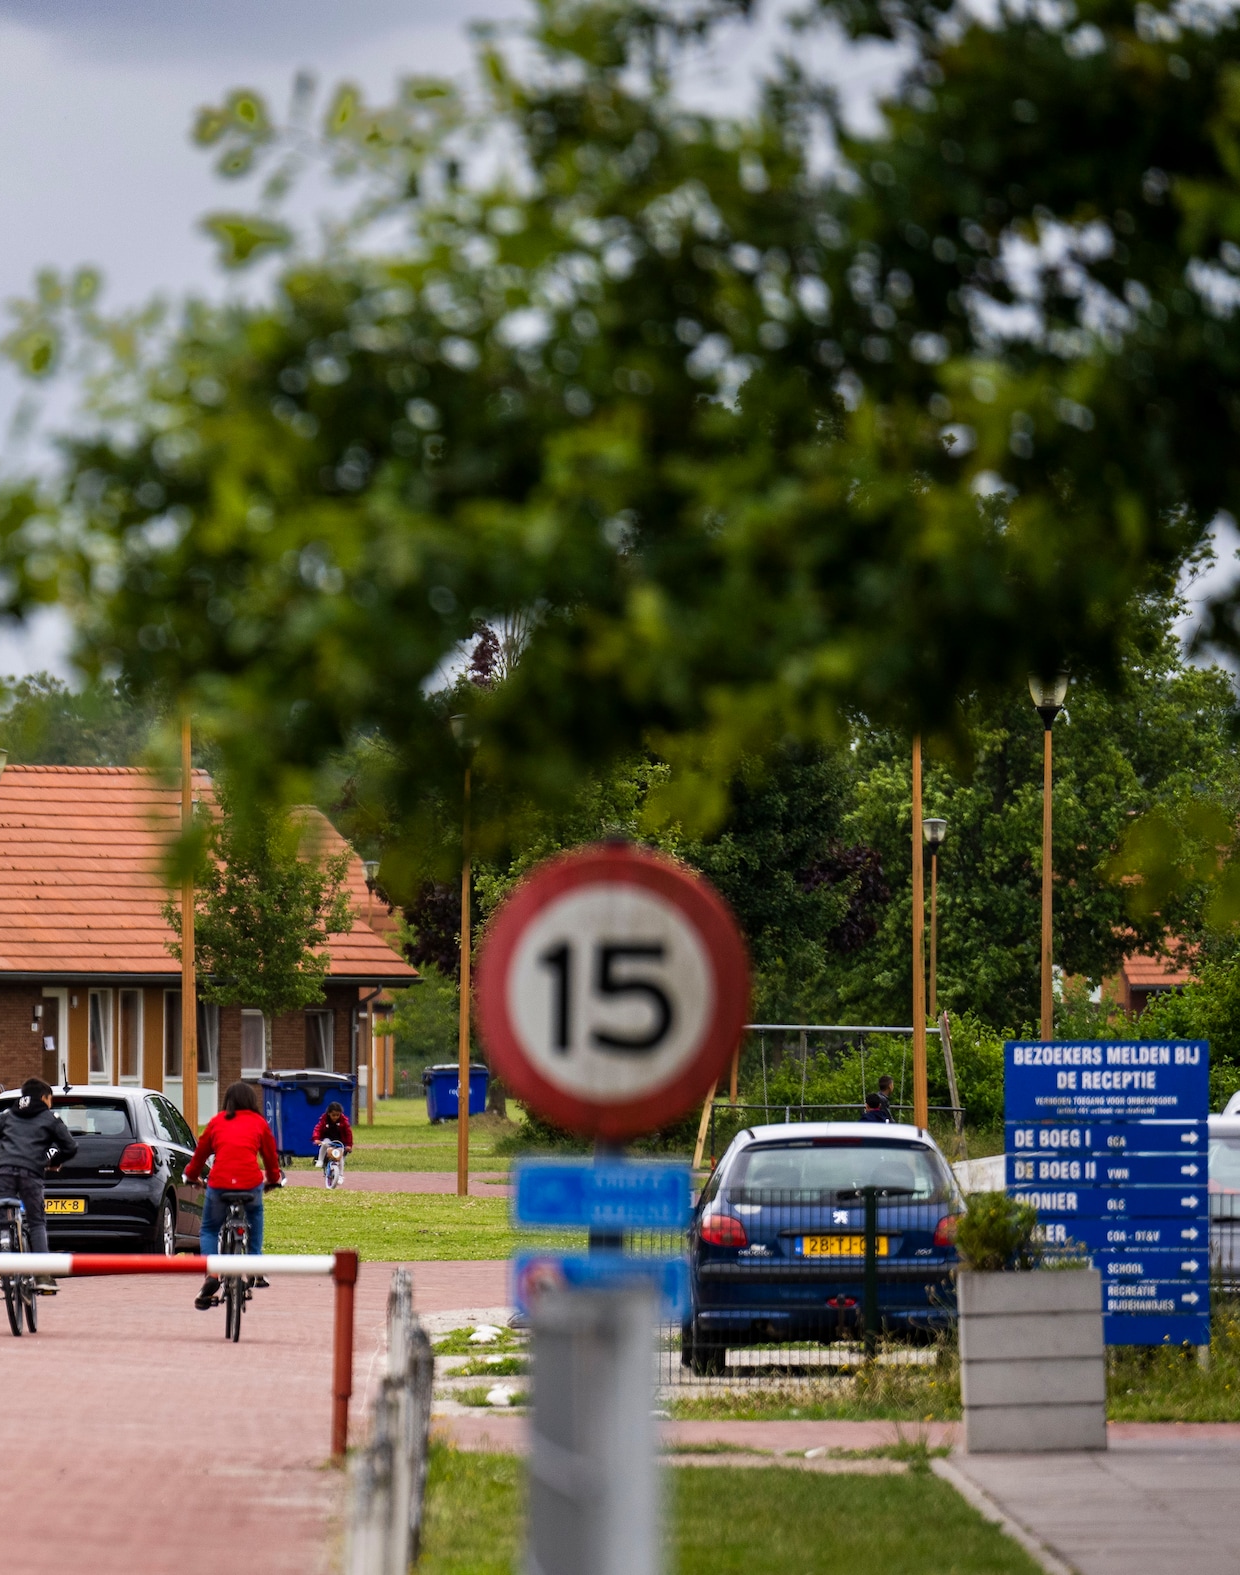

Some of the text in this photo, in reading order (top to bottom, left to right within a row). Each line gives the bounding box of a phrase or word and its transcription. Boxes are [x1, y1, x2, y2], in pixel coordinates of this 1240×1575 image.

[538, 938, 672, 1057] 15
[1013, 1046, 1200, 1065] BEZOEKERS MELDEN BIJ
[1056, 1071, 1156, 1089] DE RECEPTIE
[1106, 1096, 1125, 1105] VOOR
[1014, 1129, 1091, 1148] DE BOEG I
[1014, 1161, 1096, 1179] DE BOEG II
[45, 1200, 79, 1210] PTK-8
[1107, 1262, 1144, 1275] SCHOOL
[1107, 1285, 1156, 1296] RECREATIE
